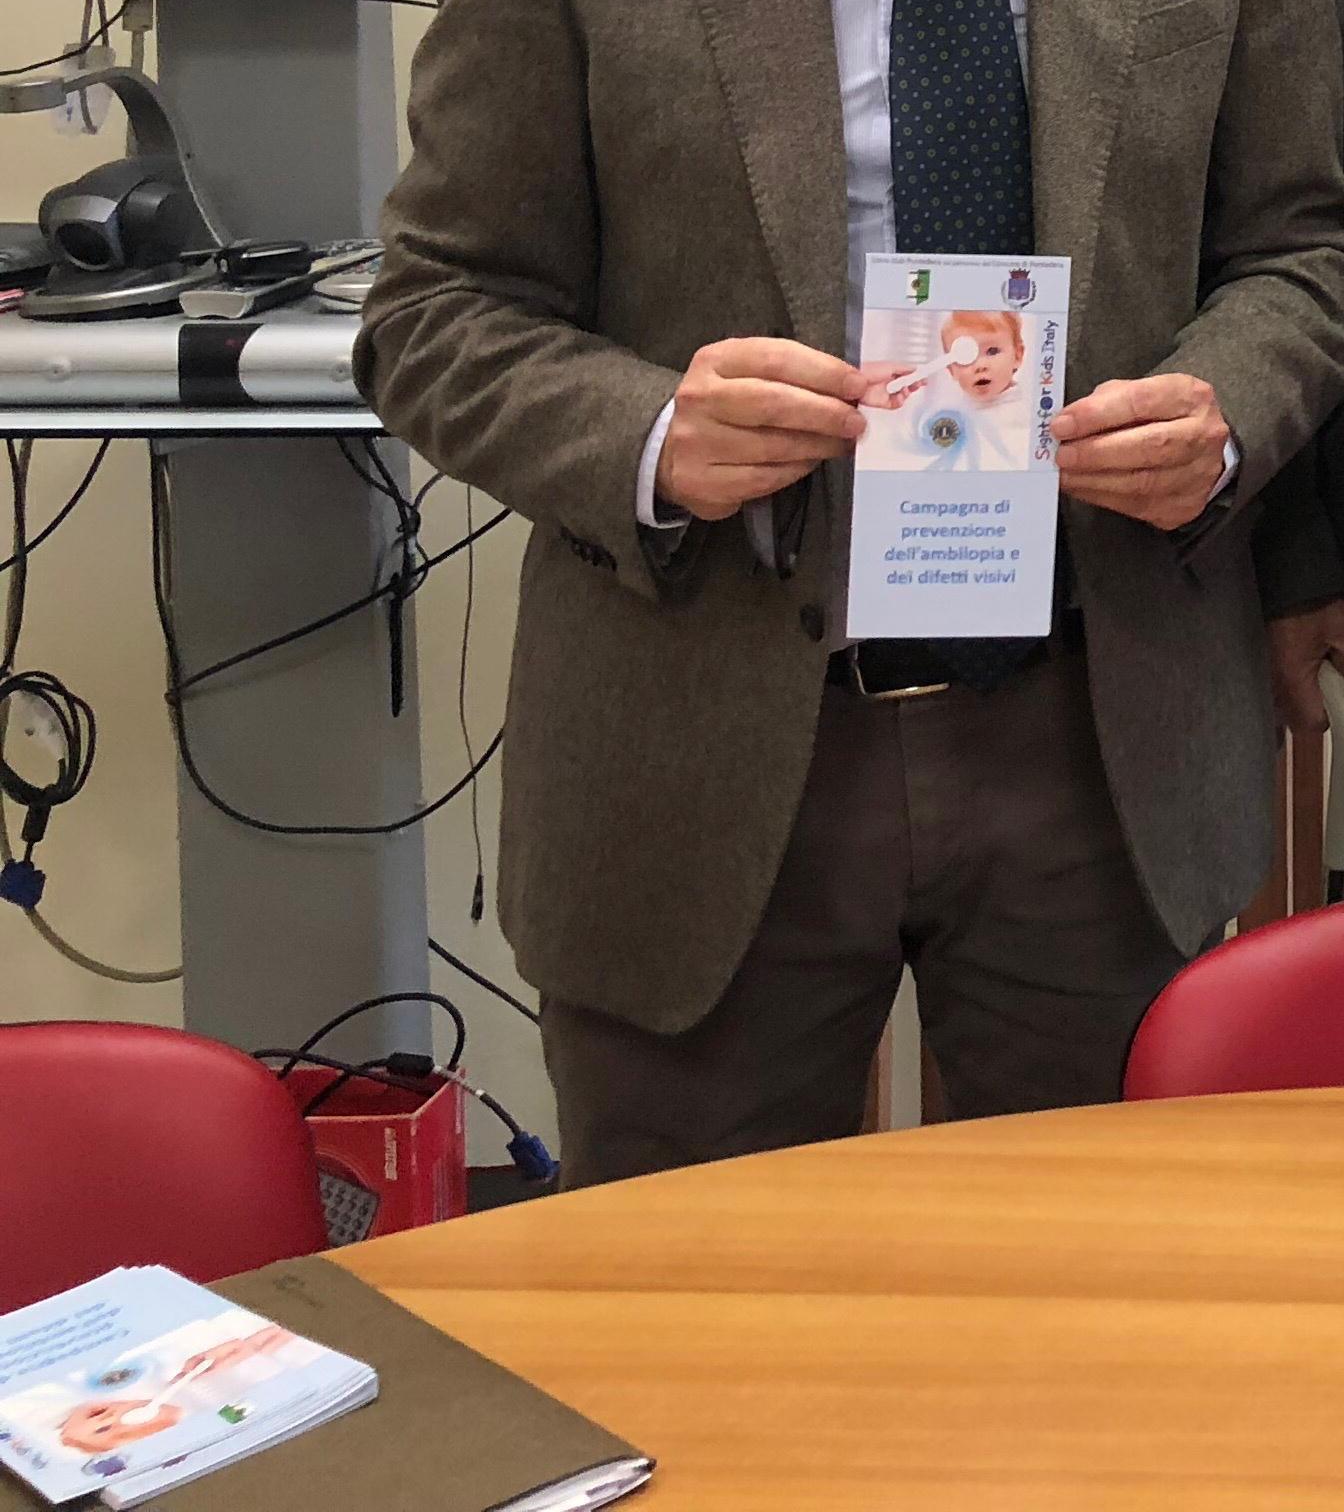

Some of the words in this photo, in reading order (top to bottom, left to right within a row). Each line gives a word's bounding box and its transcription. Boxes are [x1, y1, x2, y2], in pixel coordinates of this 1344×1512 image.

[1041, 319, 1058, 353] Italy
[1040, 355, 1054, 385] Kids
[1035, 418, 1052, 460] Sight
[900, 500, 989, 517] Campagna
[994, 499, 1010, 514] di
[901, 523, 1006, 540] prevenzione
[884, 546, 1005, 563] dell'ambliopia
[1010, 549, 1020, 561] e
[886, 570, 912, 584] dei
[918, 569, 968, 584] difetti
[973, 568, 1016, 583] visivi
